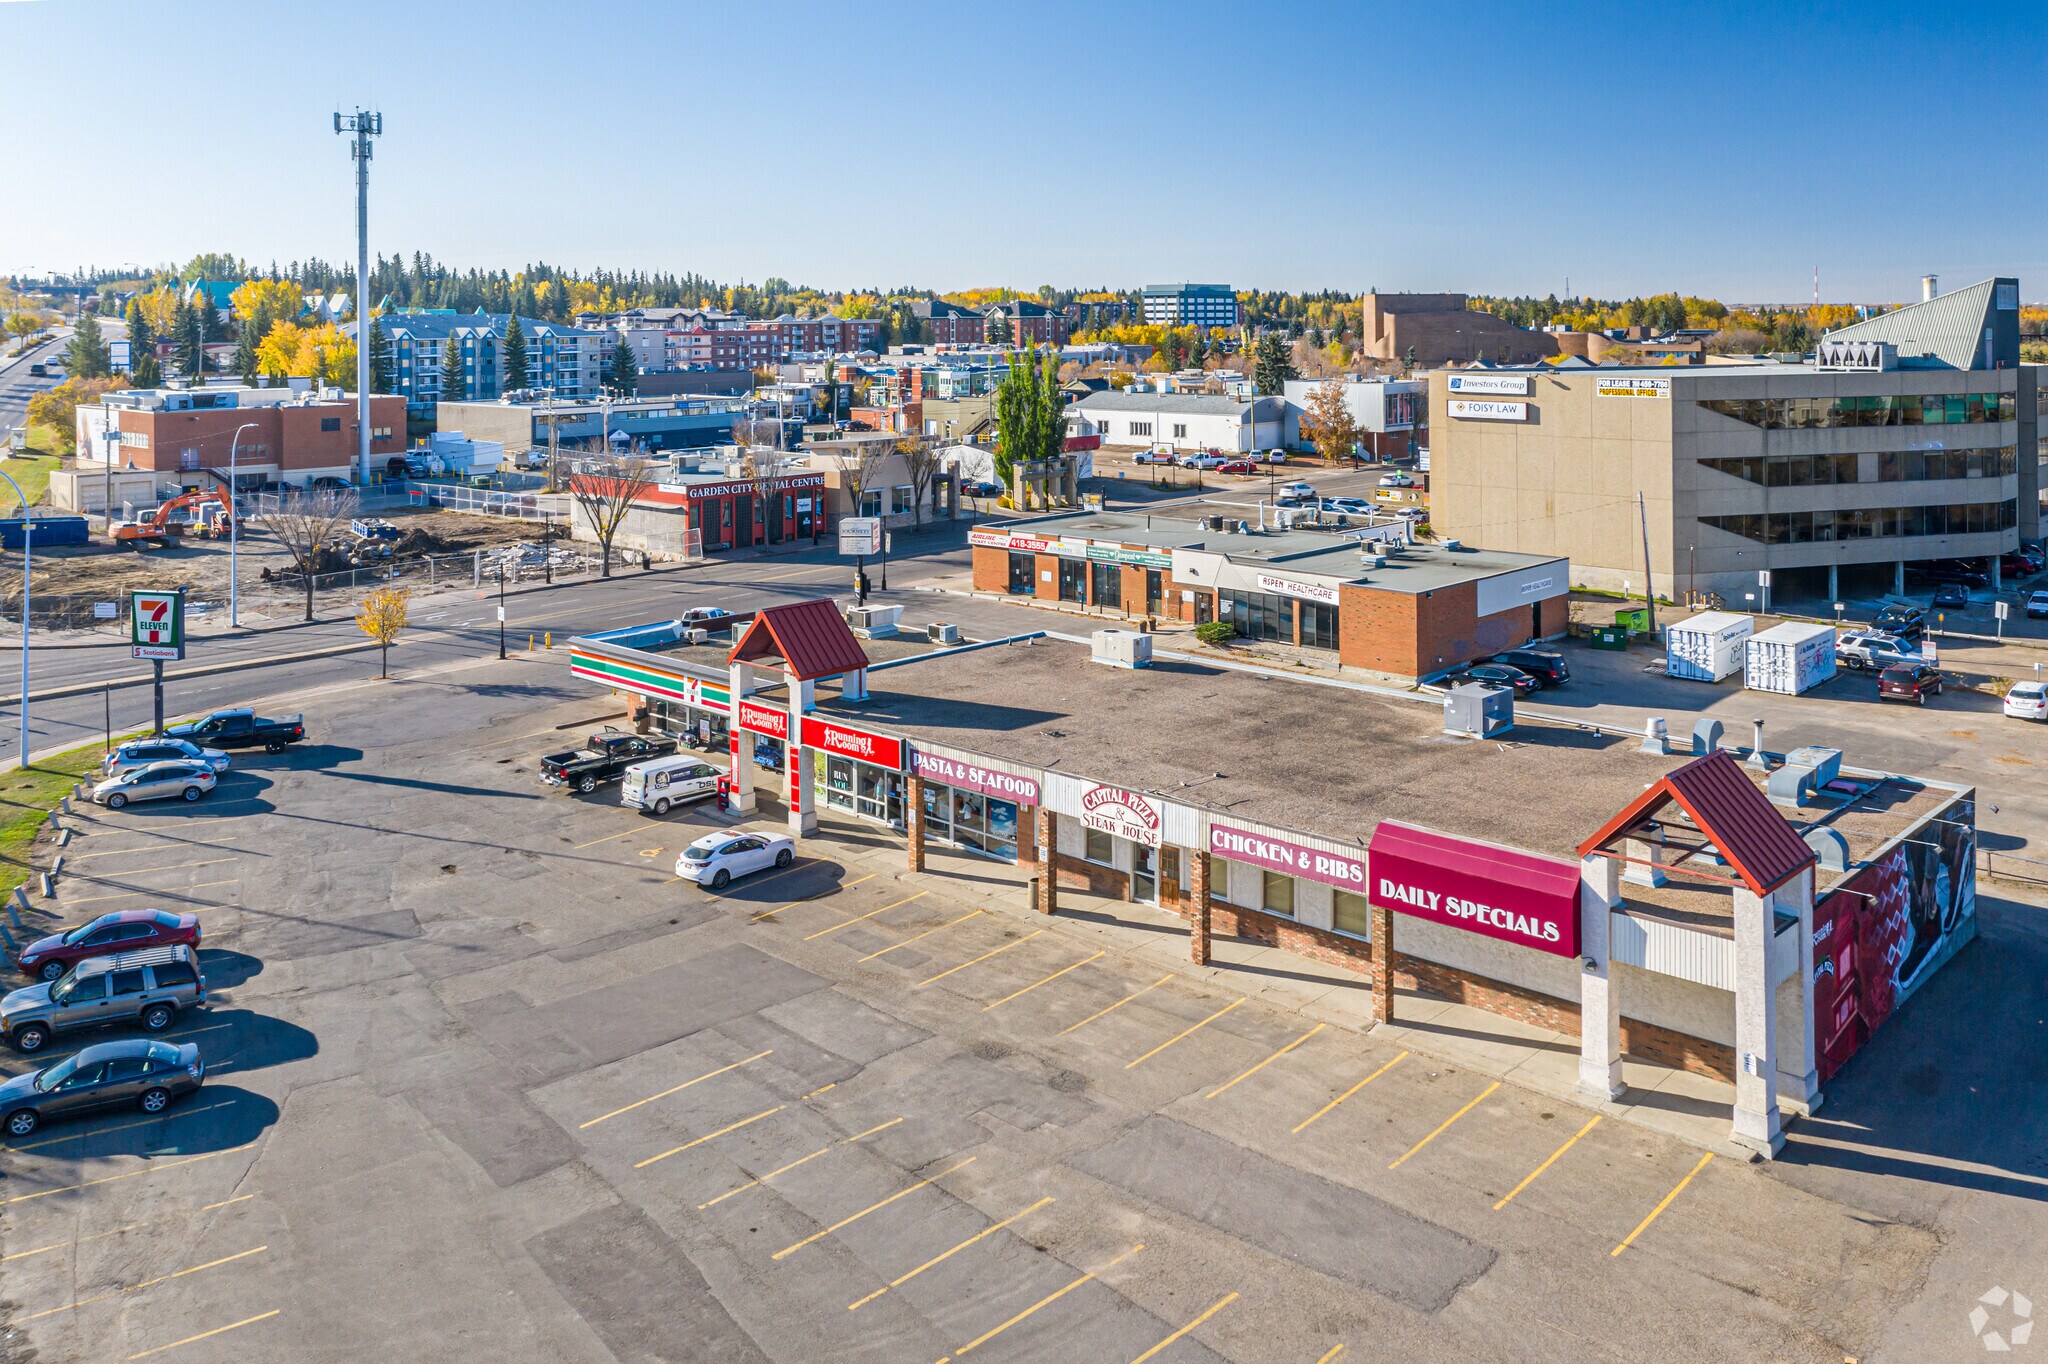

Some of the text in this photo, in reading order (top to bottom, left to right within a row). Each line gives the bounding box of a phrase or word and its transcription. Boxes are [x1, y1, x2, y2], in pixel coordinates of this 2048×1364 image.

[1463, 379, 1525, 390] Investors Group
[1599, 379, 1611, 388] FOR
[1611, 379, 1631, 388] LEASE
[1599, 388, 1635, 396] PROFESSIONAL
[1636, 389, 1657, 397] OFFICES
[1468, 403, 1518, 413] FOISY LAW
[689, 485, 730, 498] GARDEN
[731, 483, 753, 494] CITY
[791, 476, 825, 488] CENTRE
[971, 533, 1046, 551] AIRLINE 418-3555
[1262, 576, 1284, 589] ASPEN
[1287, 582, 1333, 600] HEALTHCARE
[143, 649, 175, 657] Scotiabank
[746, 708, 779, 728] Running
[830, 729, 866, 750] Running
[833, 770, 848, 782] RUN
[913, 752, 1036, 798] PASTA & SEAFOOD
[1084, 788, 1157, 827] CAPITAL PIZZA
[1115, 807, 1125, 822] &
[1082, 812, 1158, 846] STEAK HOUSE
[1211, 829, 1363, 883] CHICKEN & RIBS
[1380, 878, 1560, 942] DAILY SPECIALS
